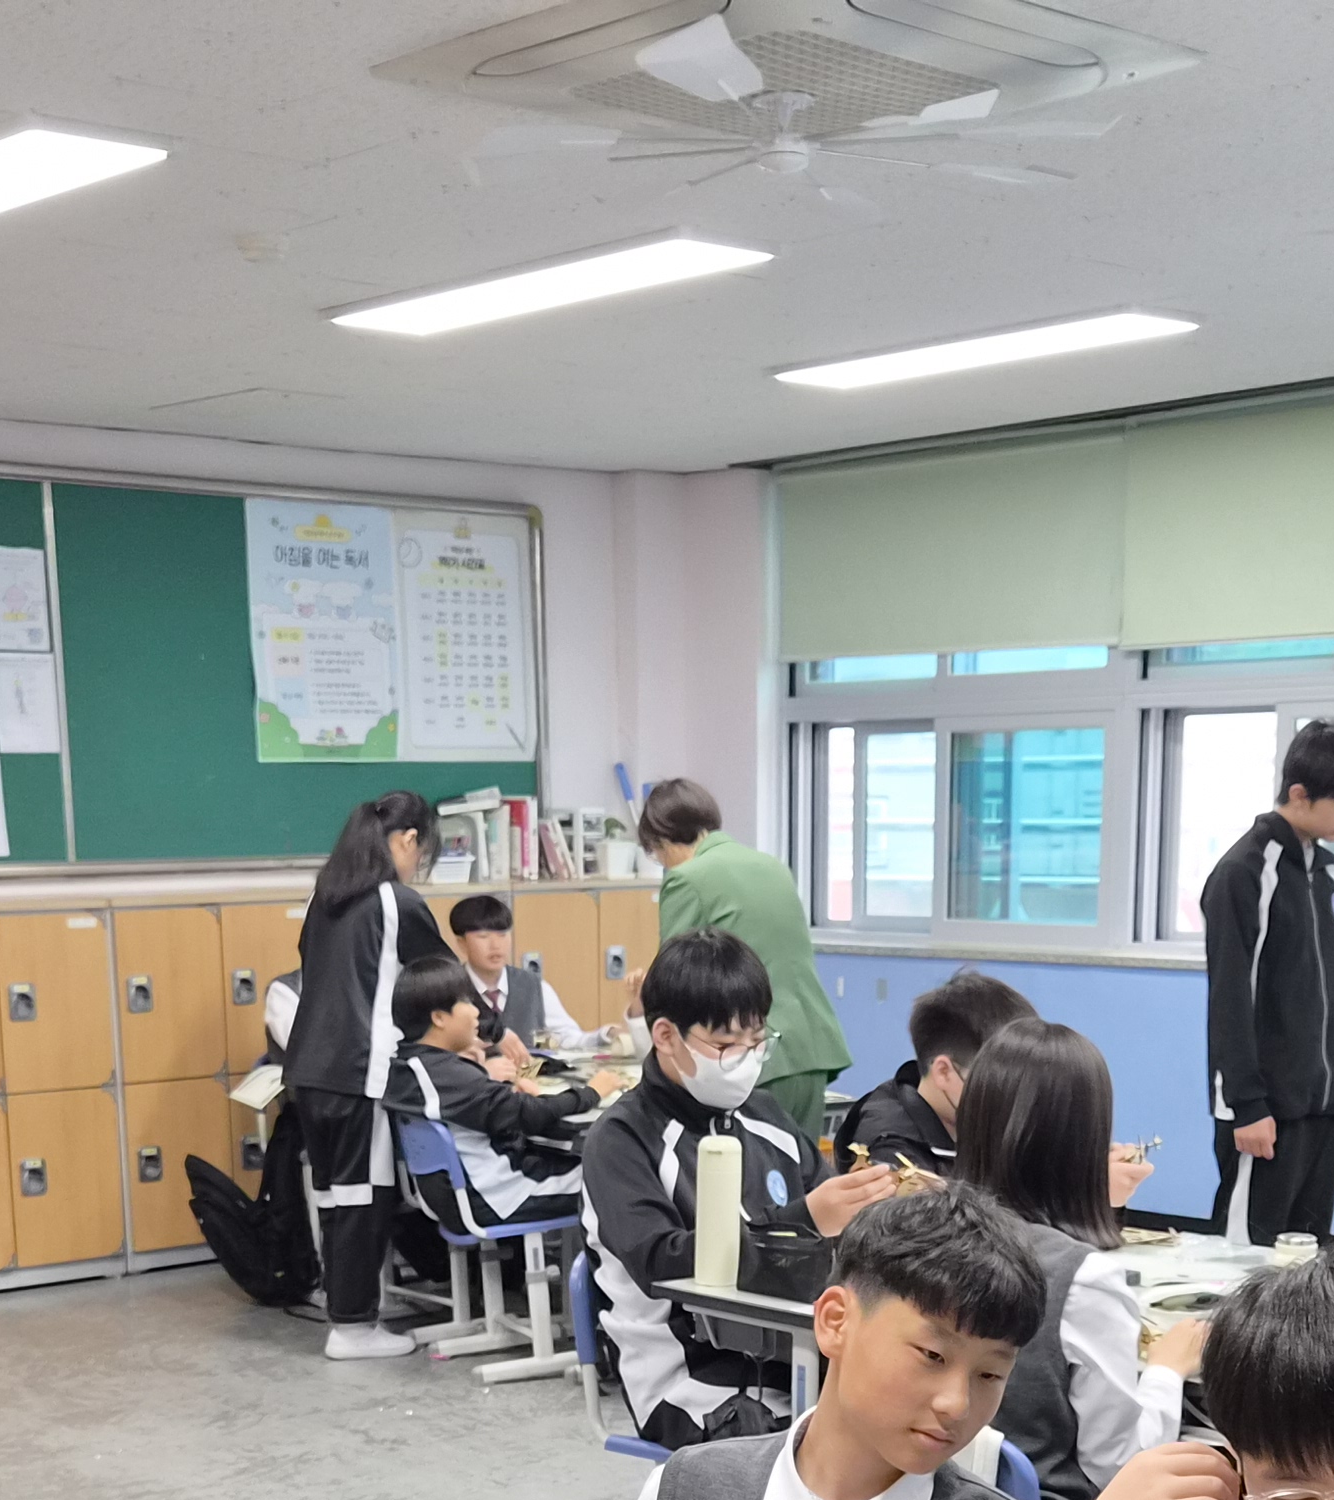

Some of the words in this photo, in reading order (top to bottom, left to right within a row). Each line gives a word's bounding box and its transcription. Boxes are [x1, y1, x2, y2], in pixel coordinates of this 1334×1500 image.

[272, 544, 313, 569] 아침을
[316, 546, 341, 570] 여는
[344, 548, 370, 571] 독서
